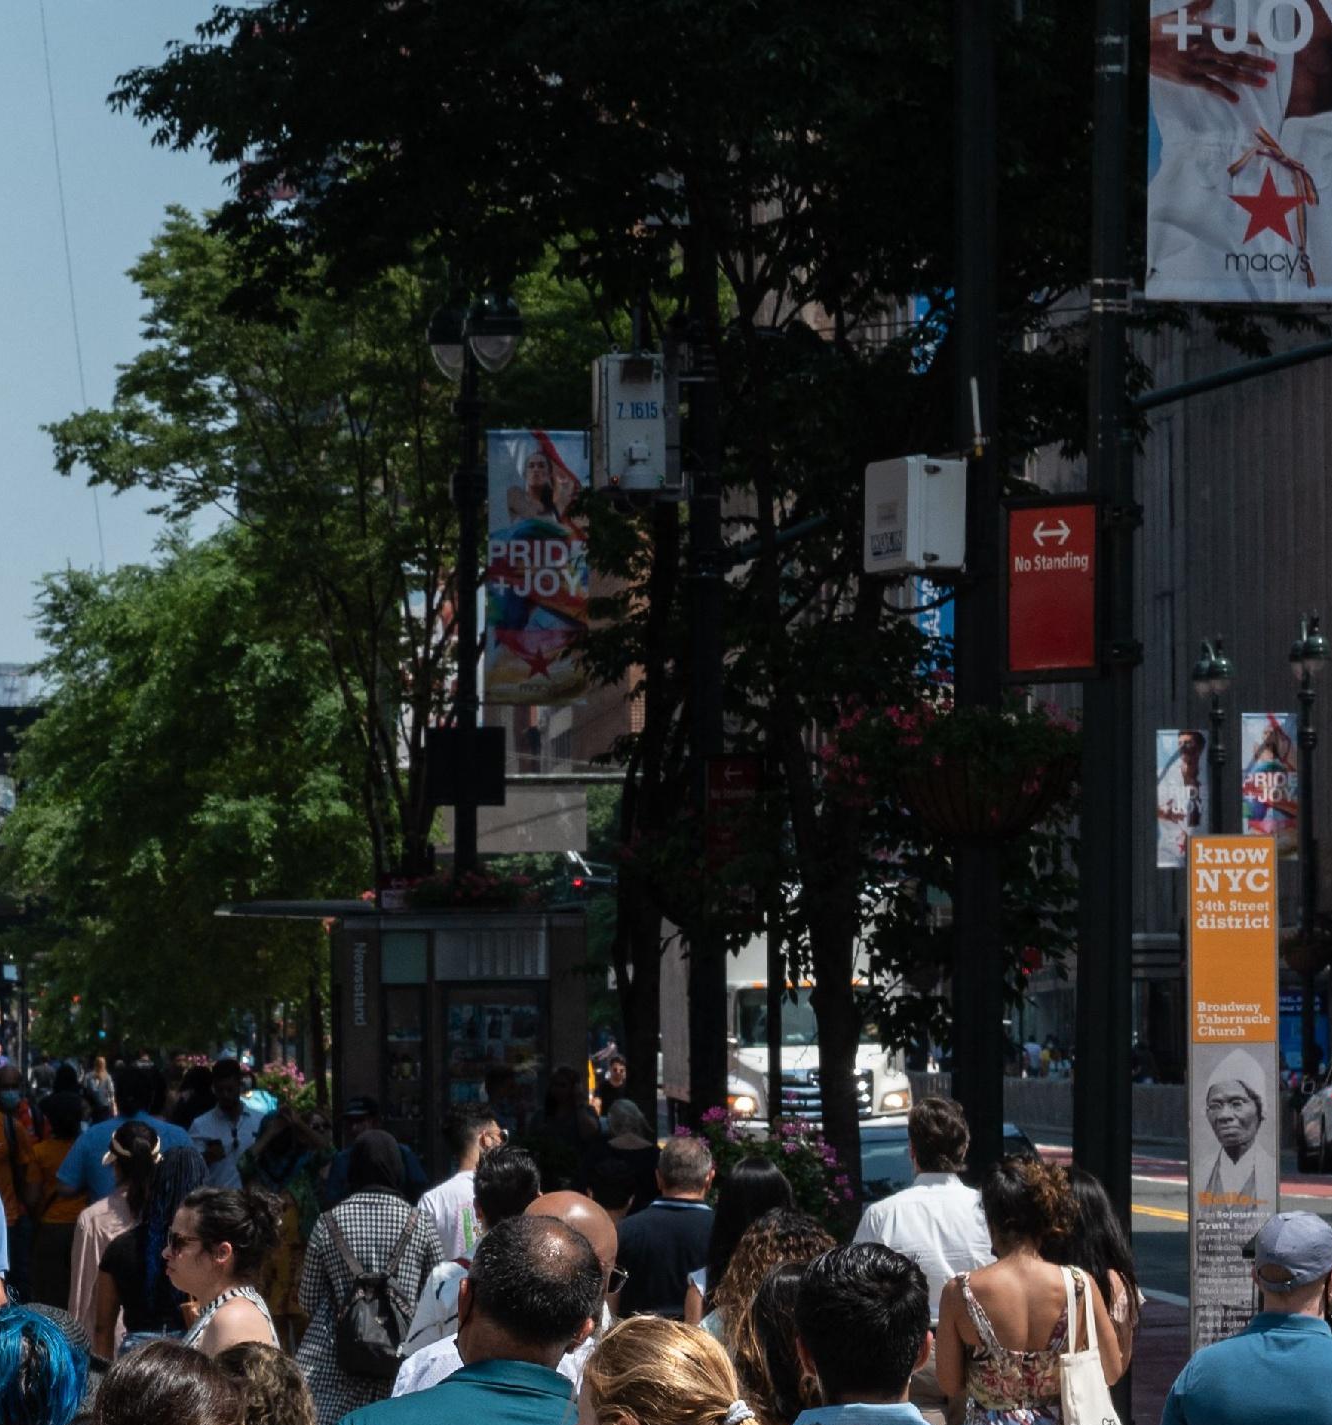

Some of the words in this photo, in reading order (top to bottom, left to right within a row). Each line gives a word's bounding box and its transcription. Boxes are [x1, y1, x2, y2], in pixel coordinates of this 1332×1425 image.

[631, 402, 658, 419] 1615
[1015, 555, 1032, 572] No
[1034, 552, 1089, 571] Standing
[1196, 843, 1269, 863] know
[1196, 869, 1269, 892] NYC
[1196, 901, 1225, 911] 34th
[1229, 901, 1269, 911] Street
[1196, 914, 1269, 929] district
[1197, 1002, 1261, 1014] Broadway
[1197, 1014, 1270, 1024] Tabernacle
[1198, 1026, 1245, 1036] Church
[1198, 1222, 1230, 1230] Truth
